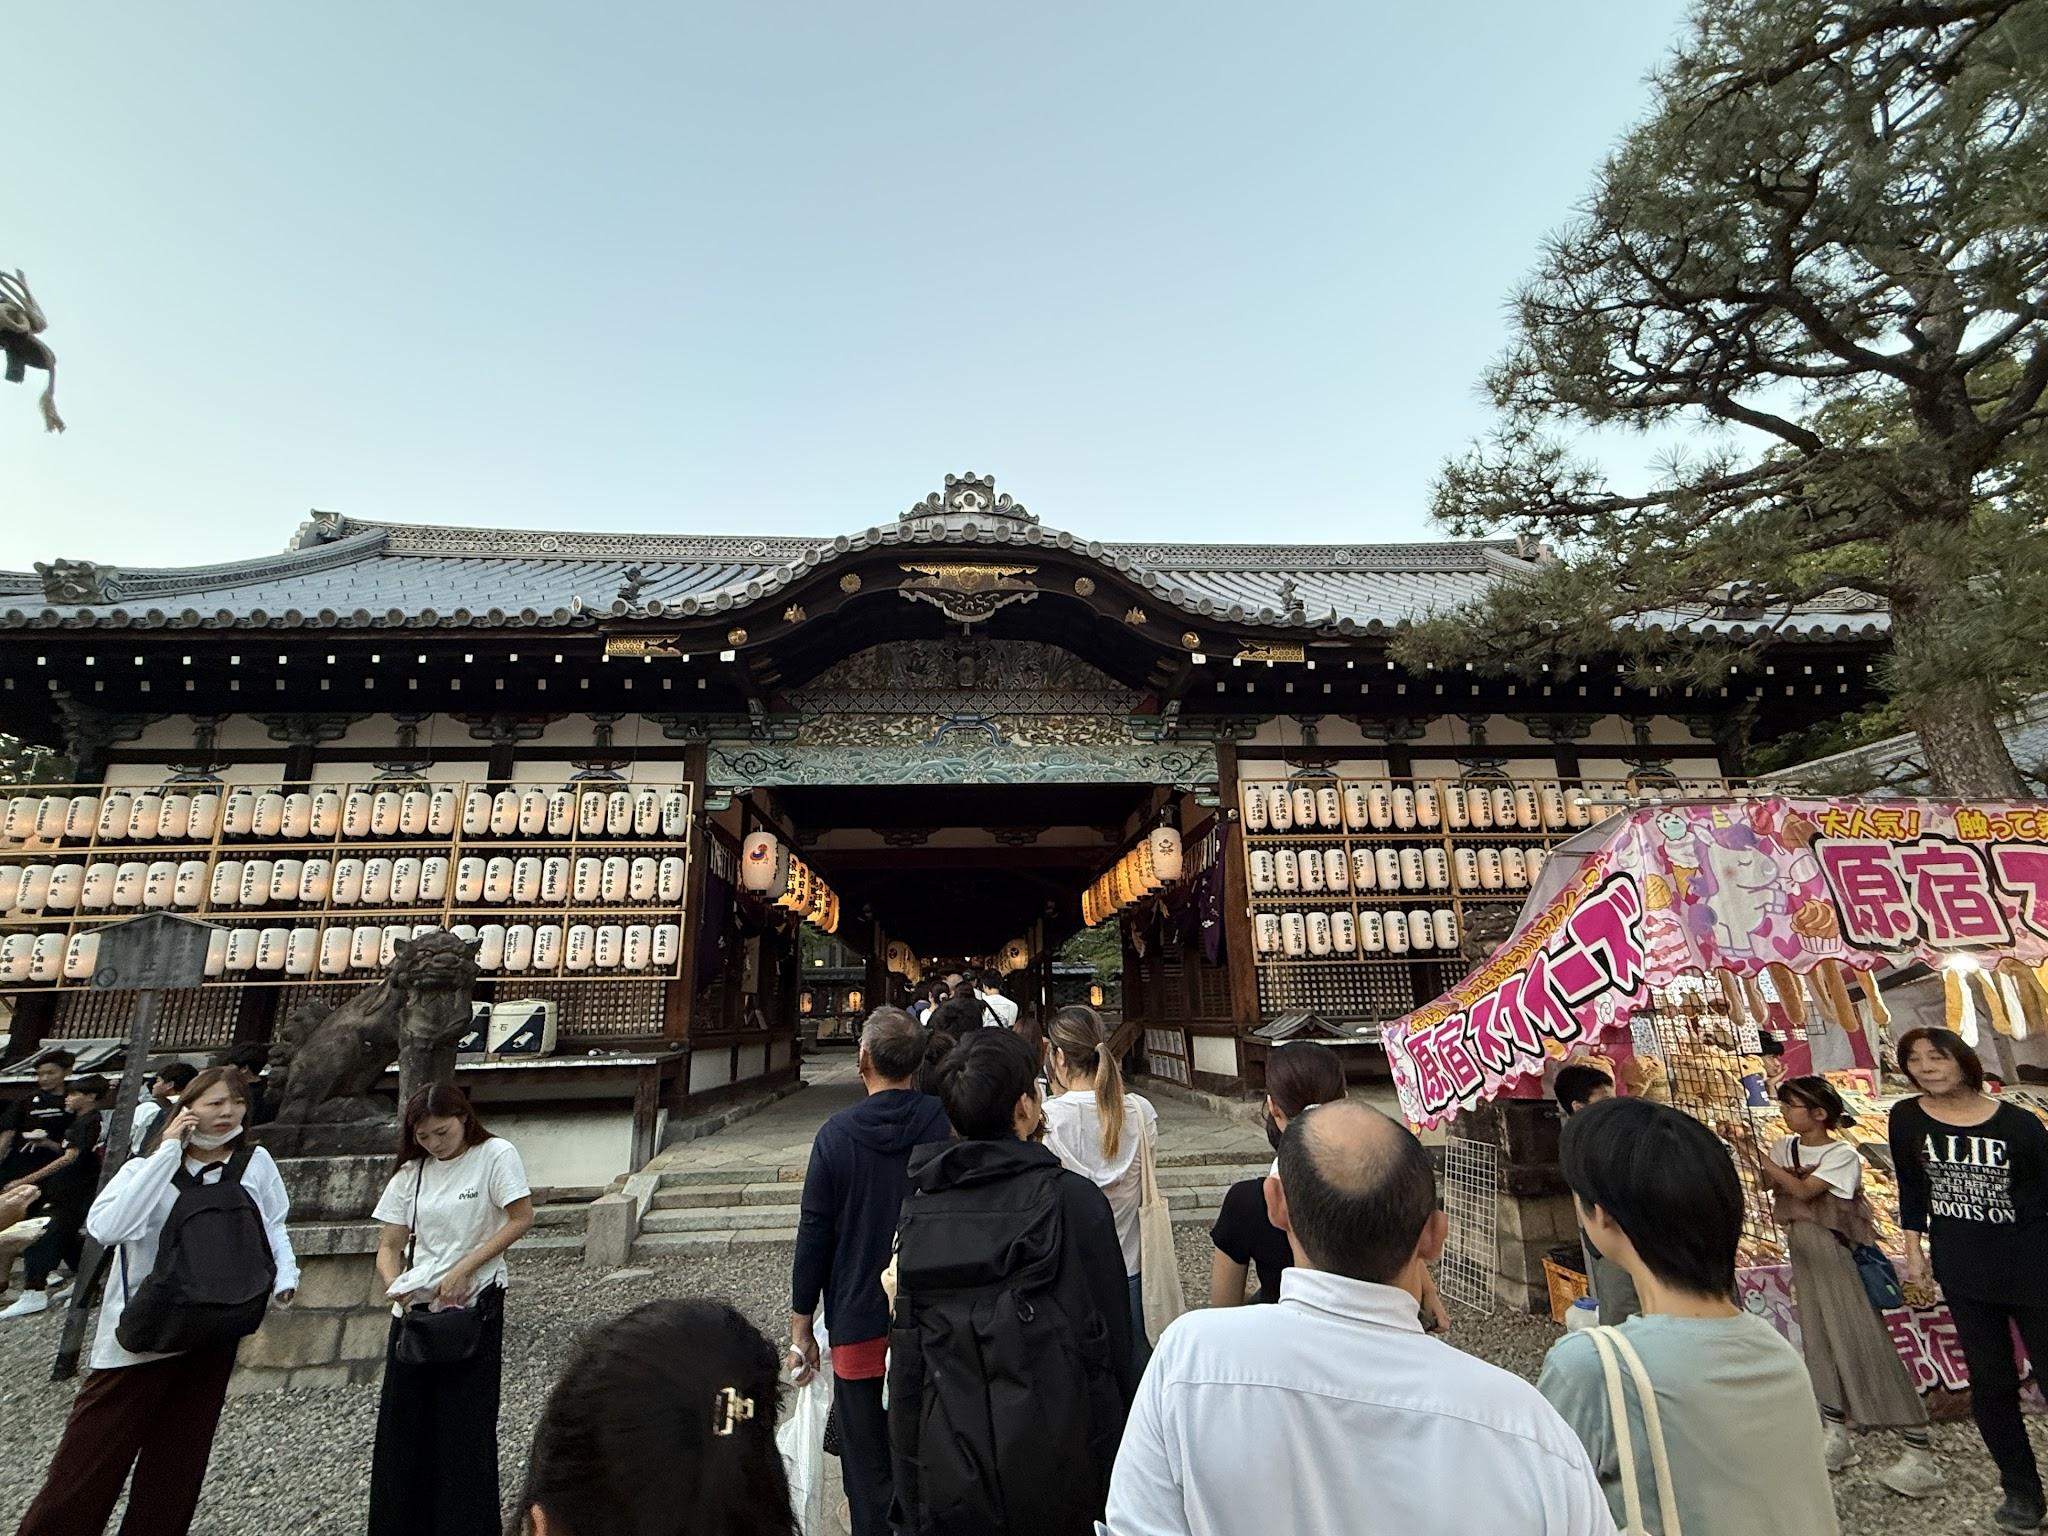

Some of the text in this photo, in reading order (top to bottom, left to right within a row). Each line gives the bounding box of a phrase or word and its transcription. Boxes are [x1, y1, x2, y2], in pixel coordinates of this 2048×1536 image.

[1819, 808, 1920, 840] 大人気!
[1405, 879, 1645, 1111] 原宿スクイーズ
[1922, 1133, 2010, 1169] A LIE
[1932, 1200, 2016, 1224] BOOTS ON
[1954, 1194, 1968, 1202] TO
